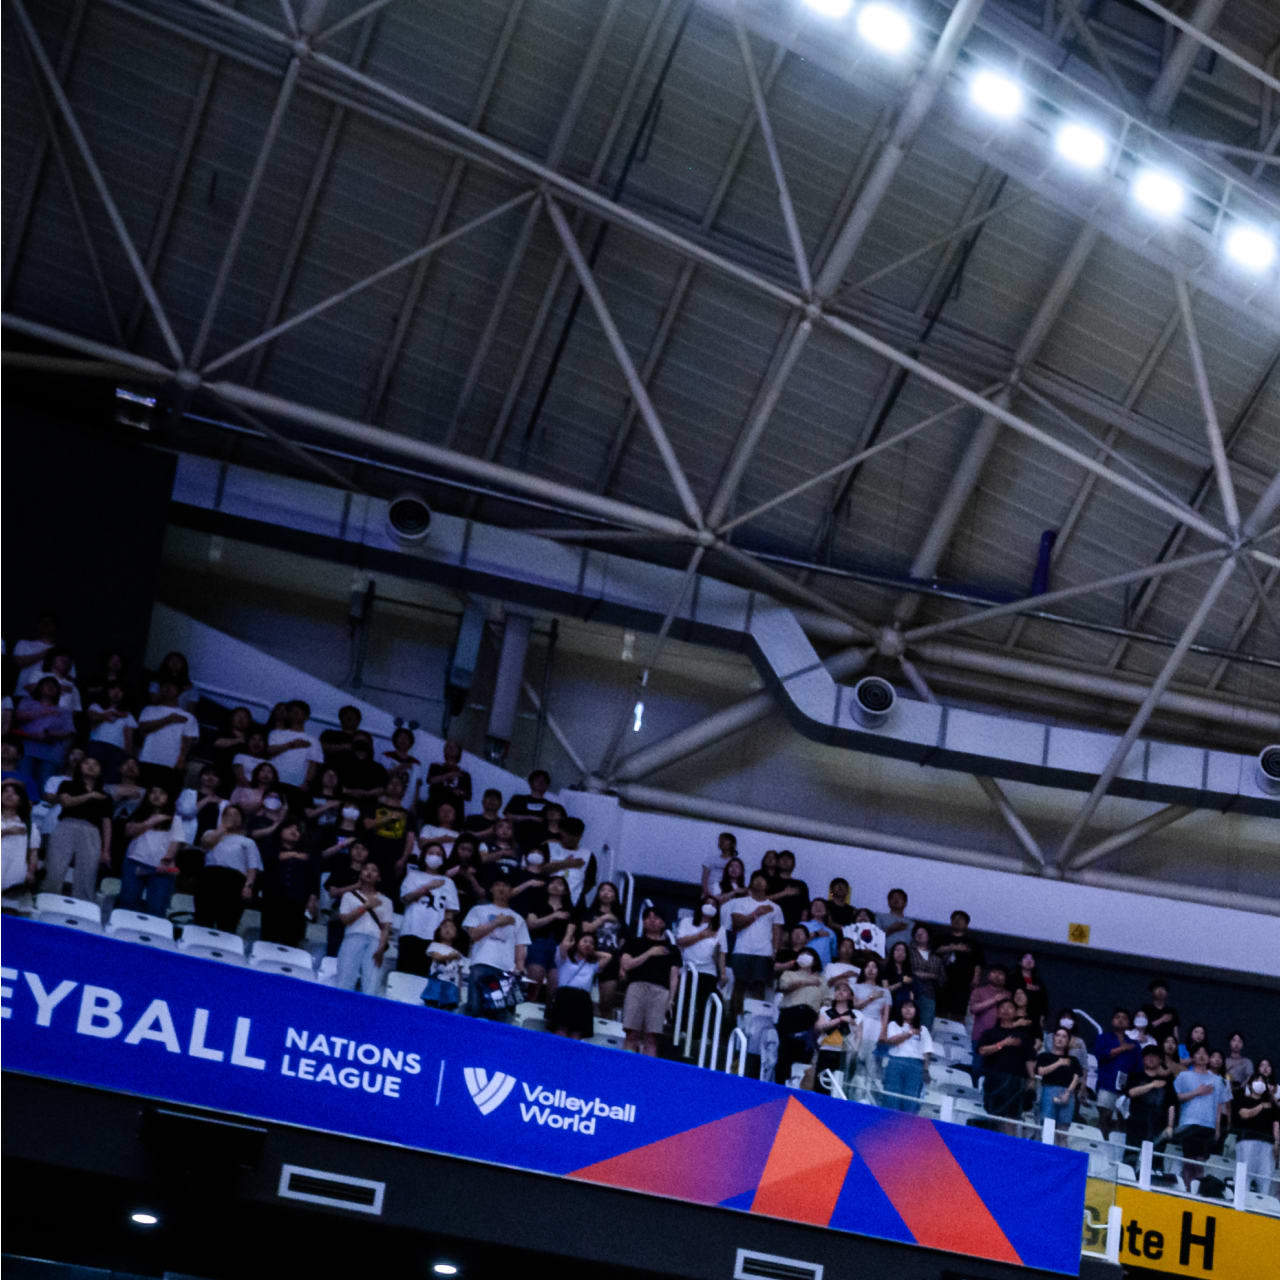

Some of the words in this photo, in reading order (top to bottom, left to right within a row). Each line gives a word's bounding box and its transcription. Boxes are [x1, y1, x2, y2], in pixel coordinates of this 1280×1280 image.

[284, 1026, 422, 1075] NATIONS
[281, 1054, 402, 1099] LEAGUE
[519, 1103, 597, 1136] World
[522, 1082, 636, 1124] Volleyball
[1179, 1211, 1216, 1271] H
